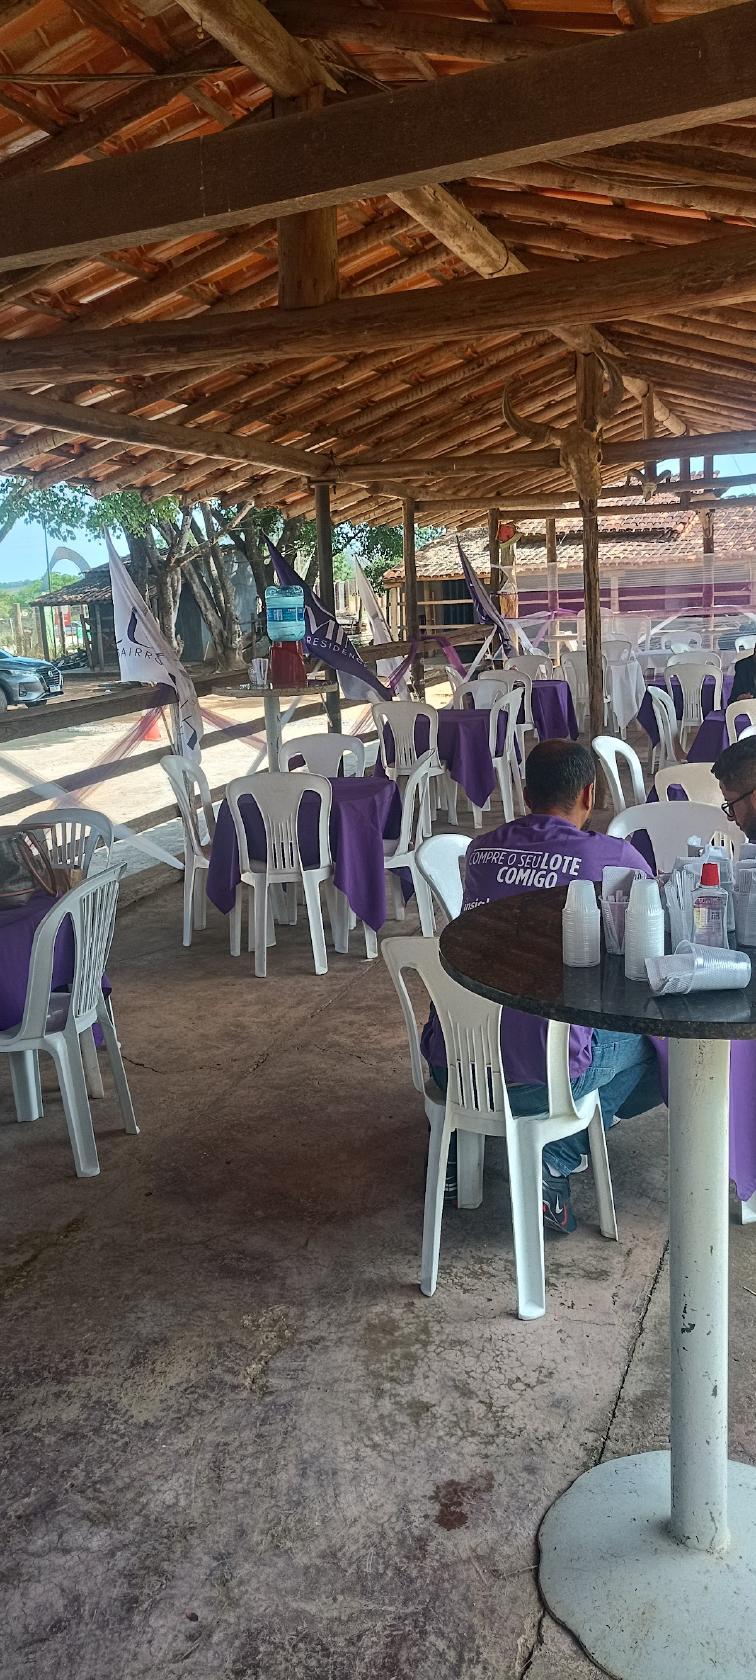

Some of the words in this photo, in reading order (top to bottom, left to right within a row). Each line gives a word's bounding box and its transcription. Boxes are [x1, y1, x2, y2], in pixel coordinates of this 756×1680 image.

[468, 851, 507, 866] COMPRE
[507, 853, 517, 868] O
[496, 866, 558, 889] COMIGO
